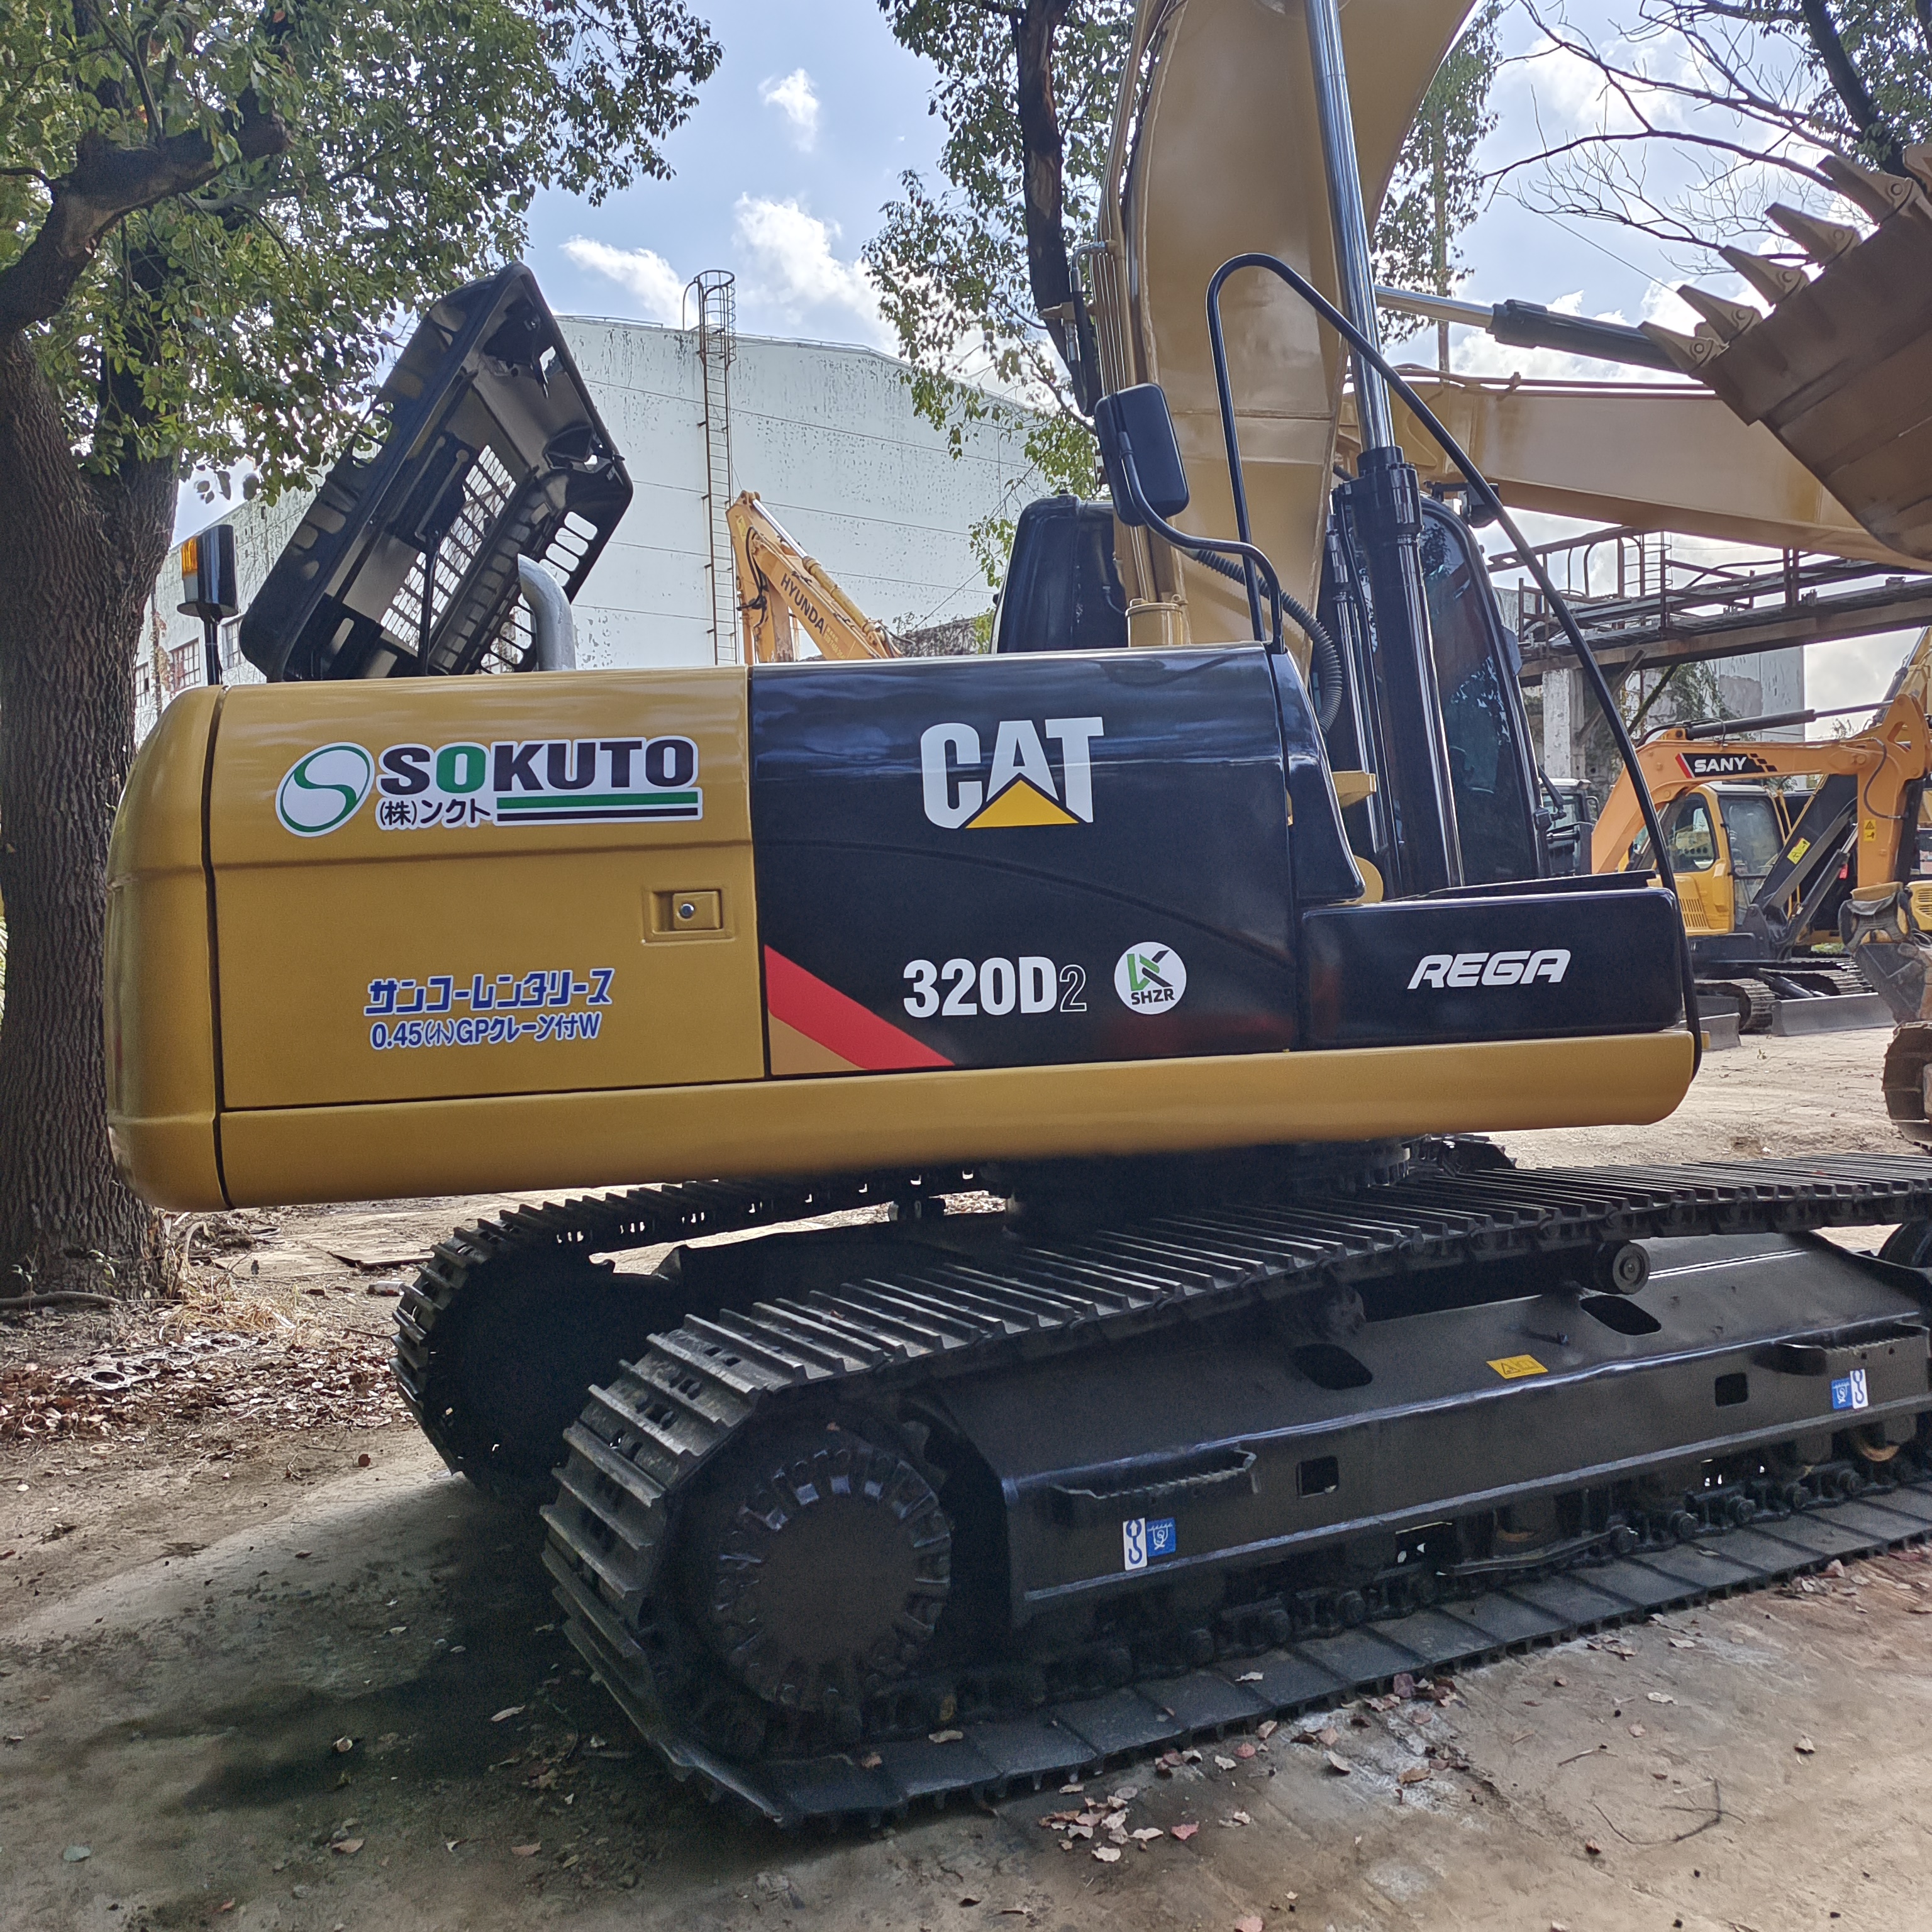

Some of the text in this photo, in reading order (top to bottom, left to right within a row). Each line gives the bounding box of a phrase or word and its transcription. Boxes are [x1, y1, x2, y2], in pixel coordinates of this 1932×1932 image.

[380, 740, 694, 795] SOKUTO
[921, 717, 1104, 829] CAT
[1694, 757, 1746, 773] SANY
[1407, 949, 1571, 989] REGA
[365, 970, 613, 1014] サンコーレンタリース
[1131, 988, 1175, 1005] SHZR
